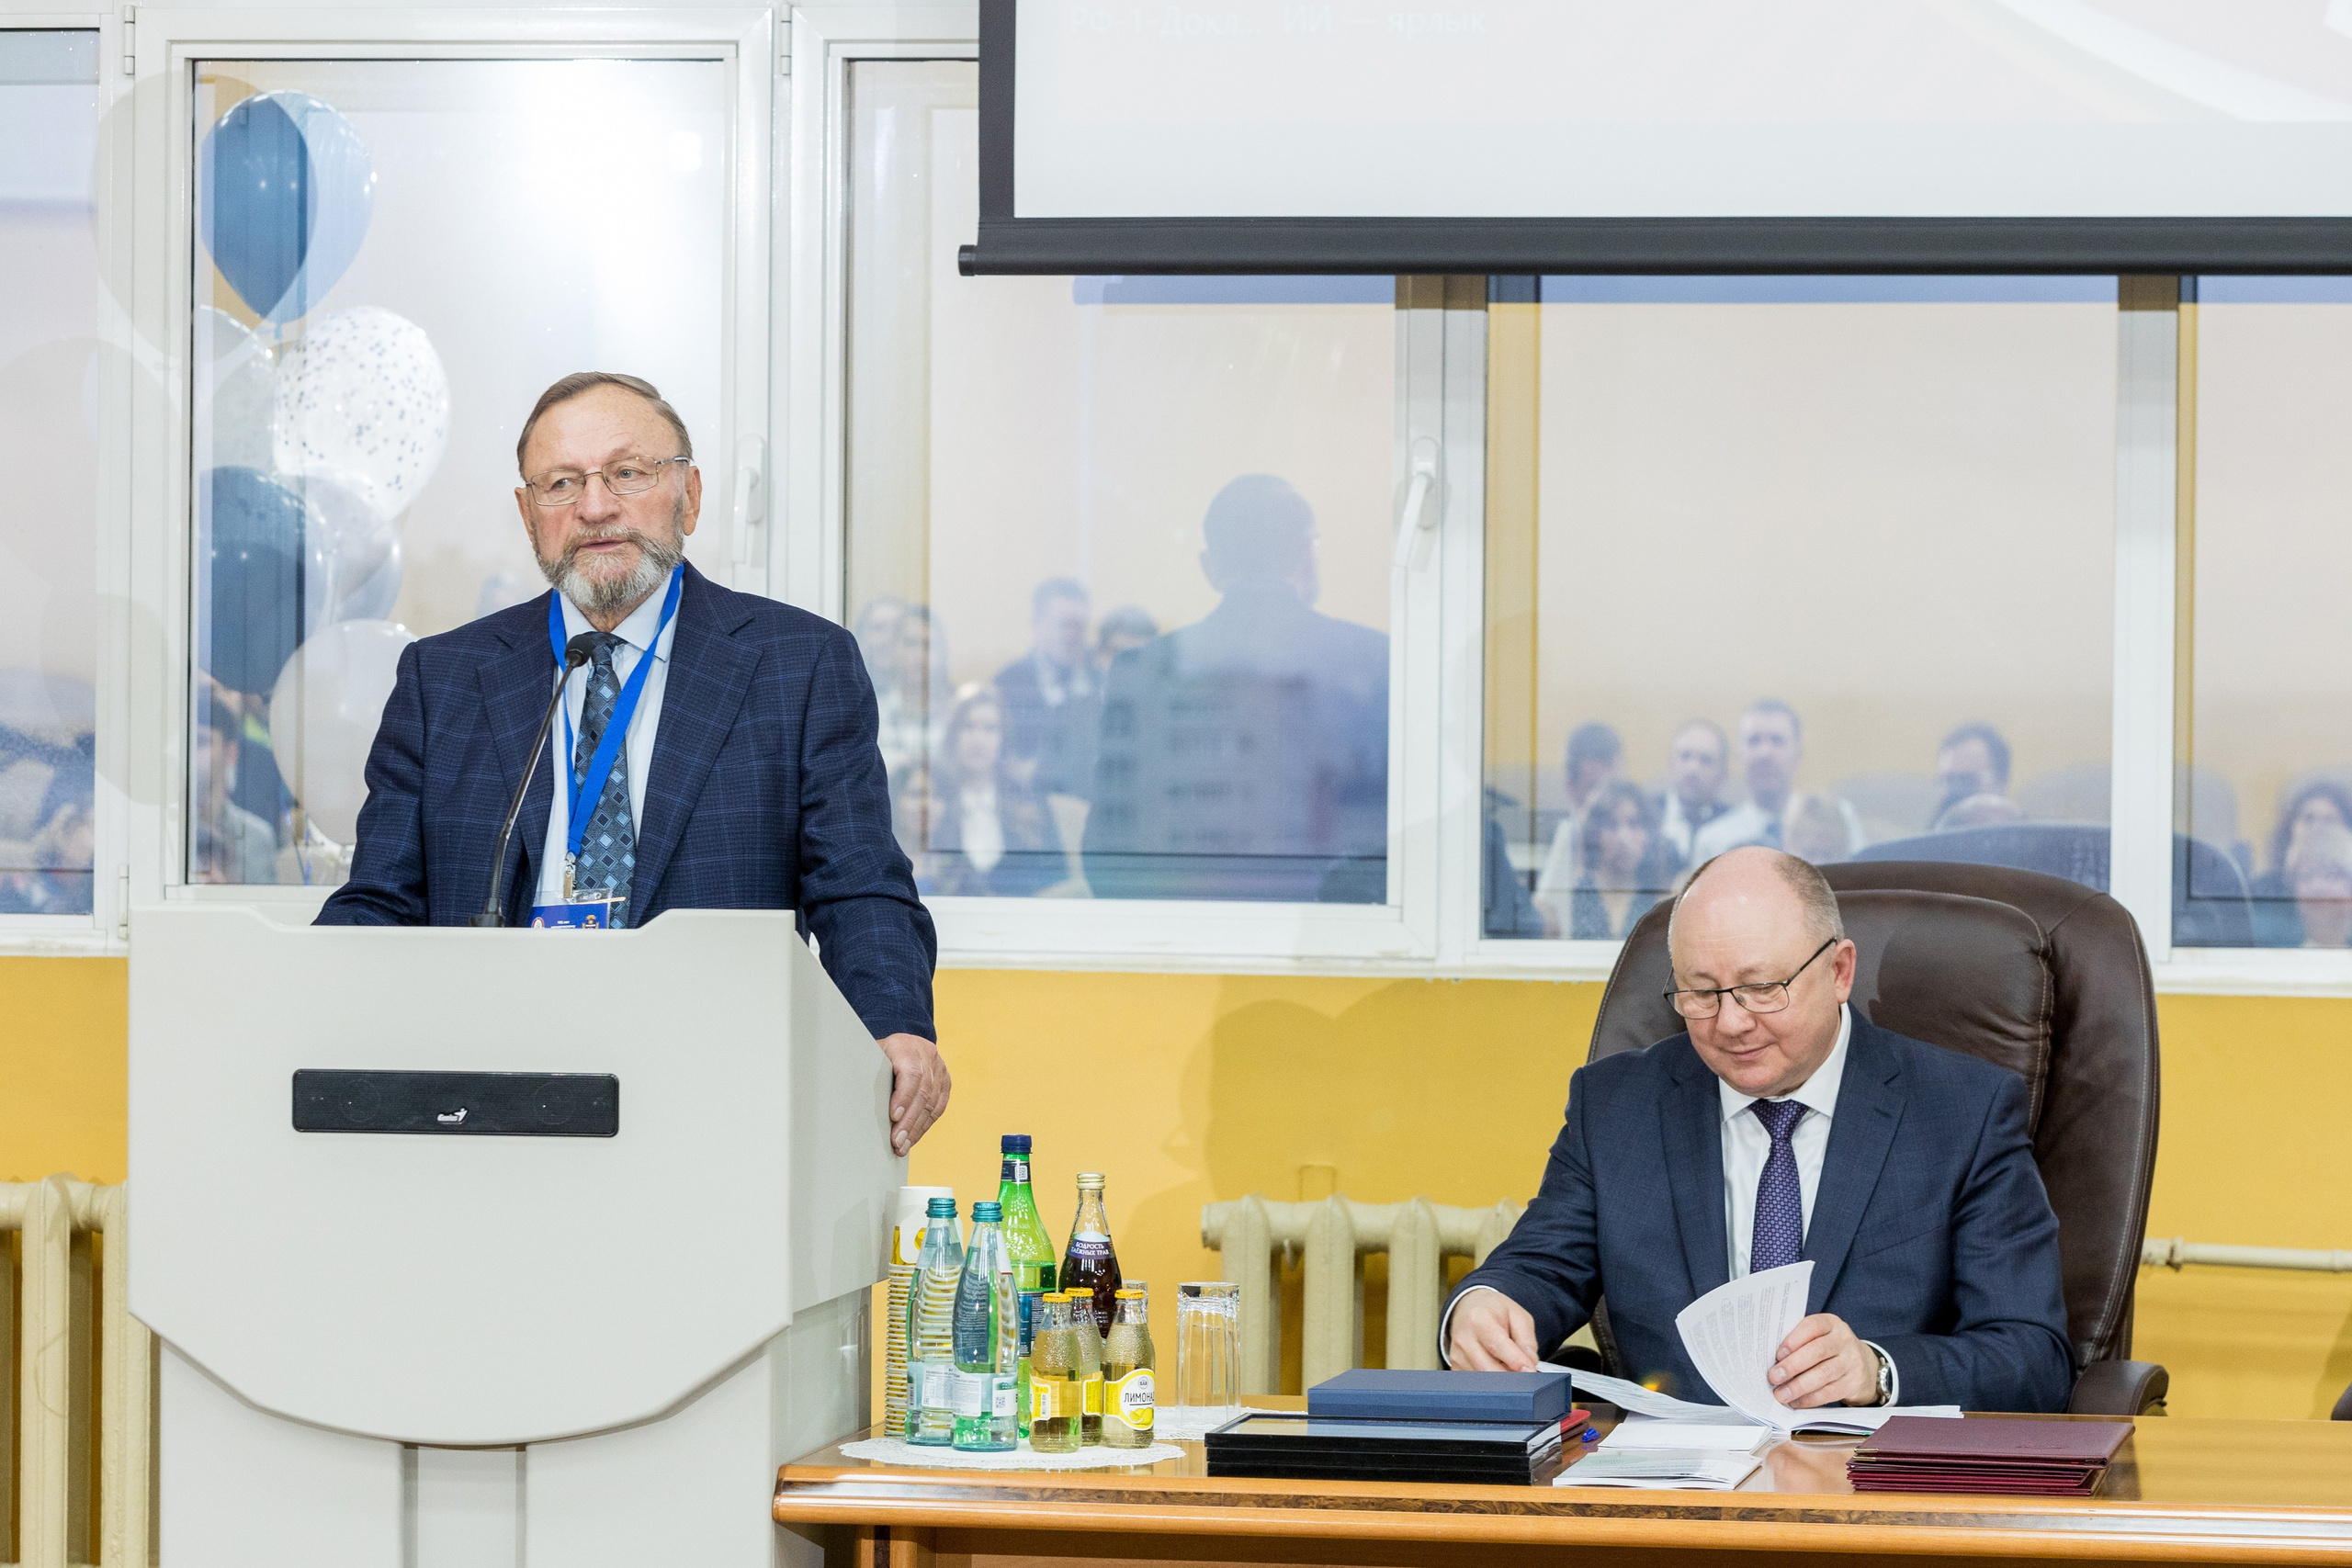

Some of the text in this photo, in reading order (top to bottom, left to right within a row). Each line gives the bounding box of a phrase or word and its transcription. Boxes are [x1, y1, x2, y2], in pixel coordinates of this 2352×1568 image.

[1283, 5, 1333, 35] ИИ
[1386, 11, 1488, 41] ярлык
[1076, 1241, 1104, 1249] БОДРОСТЬ
